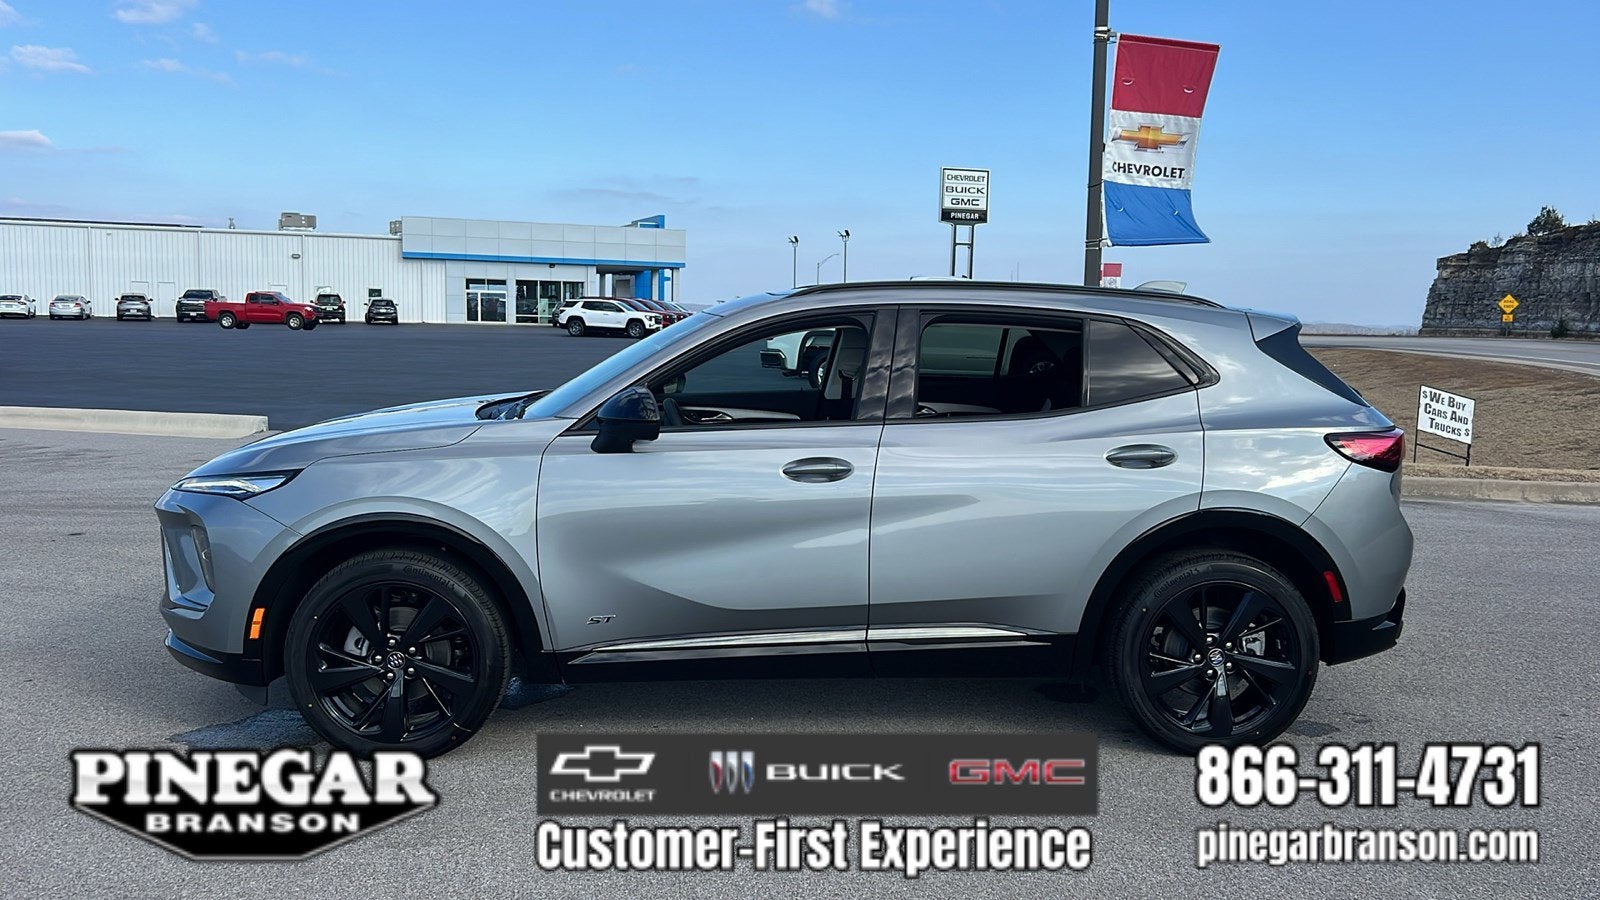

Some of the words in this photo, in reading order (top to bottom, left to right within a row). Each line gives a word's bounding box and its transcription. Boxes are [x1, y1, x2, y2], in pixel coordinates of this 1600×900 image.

[1112, 161, 1185, 179] CHEVROLET
[946, 173, 986, 182] CHEVROLET
[945, 185, 985, 194] BUICK
[950, 198, 980, 206] GMC
[1448, 396, 1467, 411] BUY
[1424, 402, 1448, 420] CARS
[1450, 410, 1469, 425] AND
[1428, 417, 1462, 436] TRUCKS
[586, 614, 617, 625] ST
